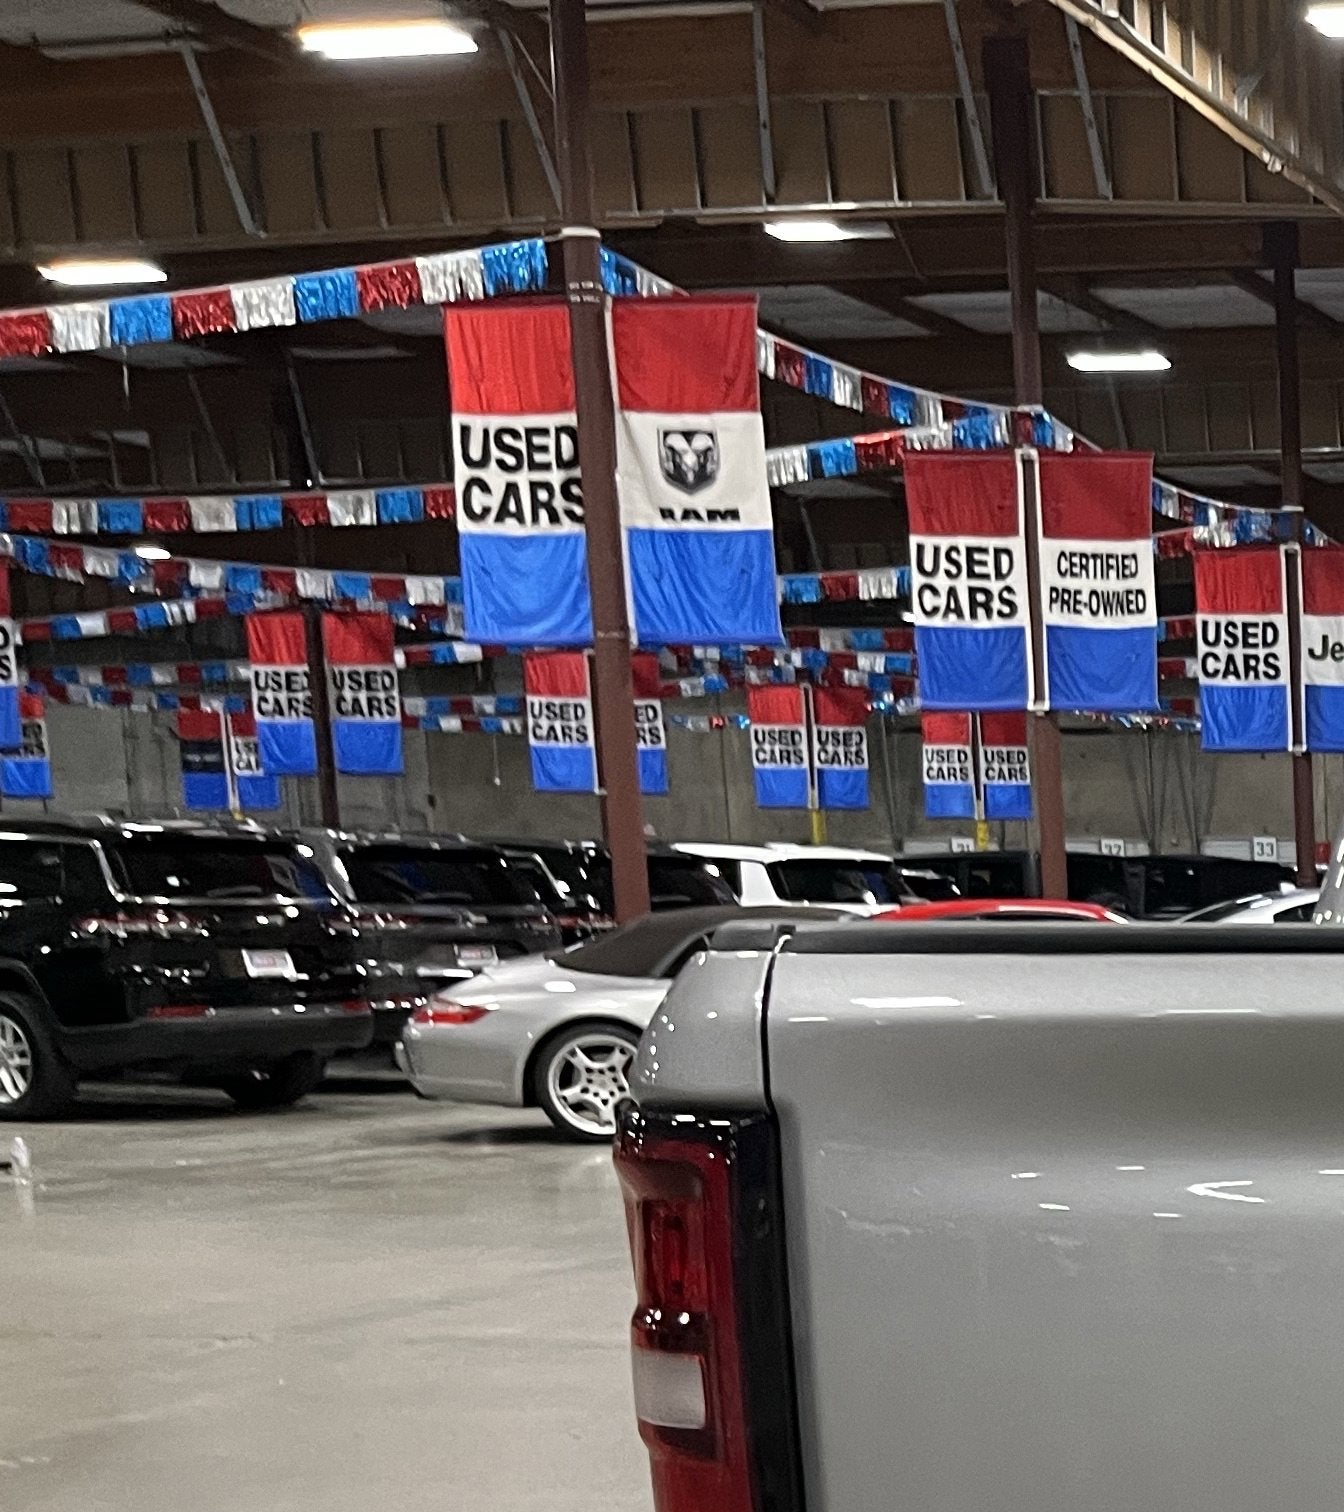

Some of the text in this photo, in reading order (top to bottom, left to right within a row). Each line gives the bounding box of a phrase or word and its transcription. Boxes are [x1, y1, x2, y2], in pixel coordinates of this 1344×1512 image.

[460, 424, 580, 473] USED
[462, 476, 586, 525] CARS
[916, 543, 1014, 581] USED
[1057, 550, 1138, 581] CERTIFIED
[917, 583, 1019, 621] CARS
[1049, 586, 1147, 617] PRE-OWNED
[1201, 620, 1280, 649] USED
[1201, 652, 1282, 681] CARS
[332, 670, 395, 692] USED
[335, 695, 397, 718] CARS
[529, 702, 586, 722] USED
[532, 724, 589, 745] CARS
[754, 728, 802, 747] USED
[817, 728, 864, 748] USED
[755, 748, 804, 766] CARS
[817, 748, 865, 766] CARS
[926, 749, 969, 763] USED
[984, 749, 1027, 764] USED
[926, 766, 970, 782] CARS
[984, 766, 1029, 783] CARS
